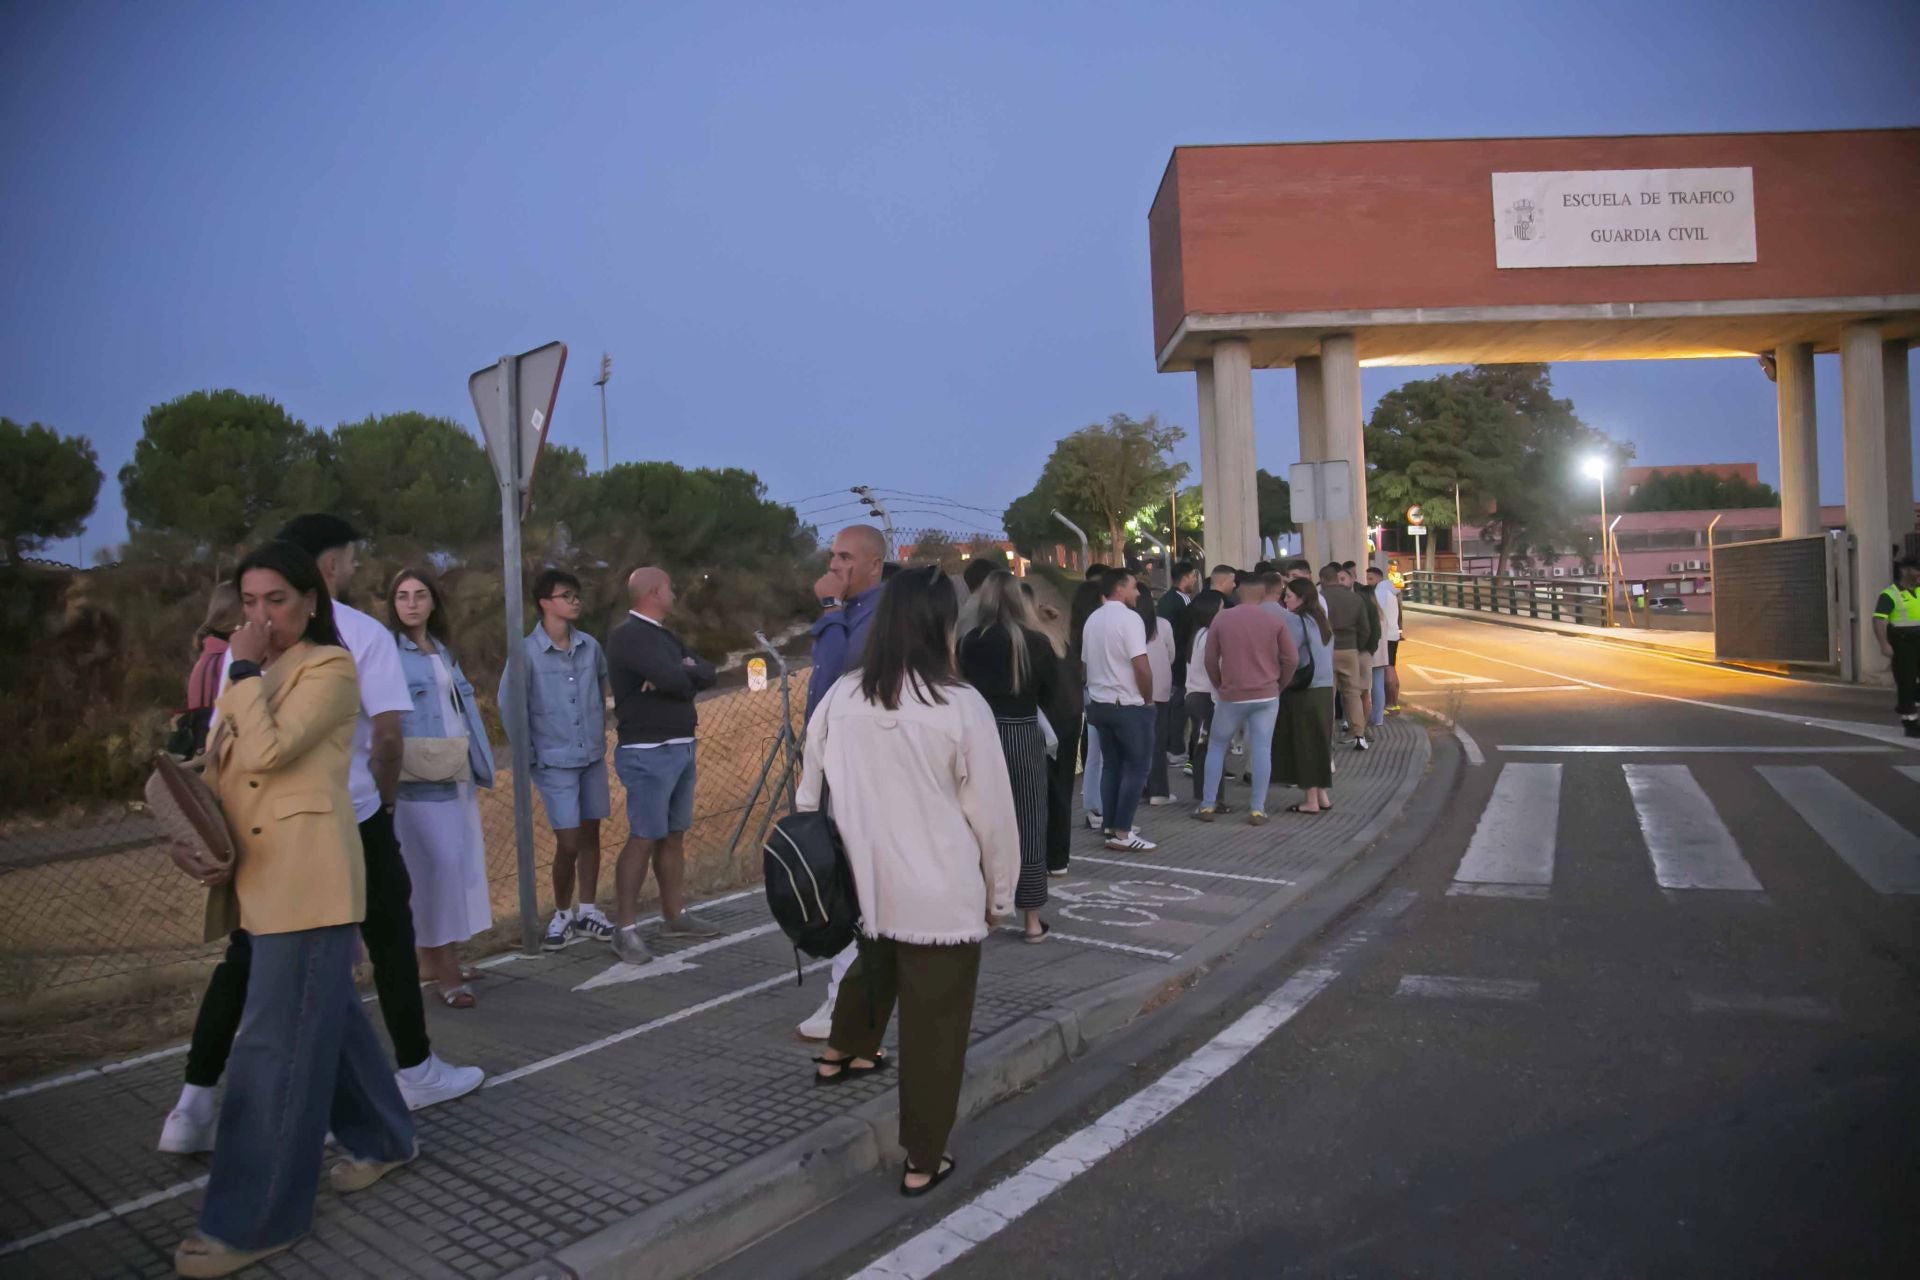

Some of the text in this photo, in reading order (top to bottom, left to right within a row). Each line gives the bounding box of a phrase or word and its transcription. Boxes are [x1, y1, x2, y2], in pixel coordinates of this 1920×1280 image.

[1563, 190, 1734, 207] ESCUELA DE TRAFICO
[1591, 227, 1709, 243] GUARDIA CIVIL
